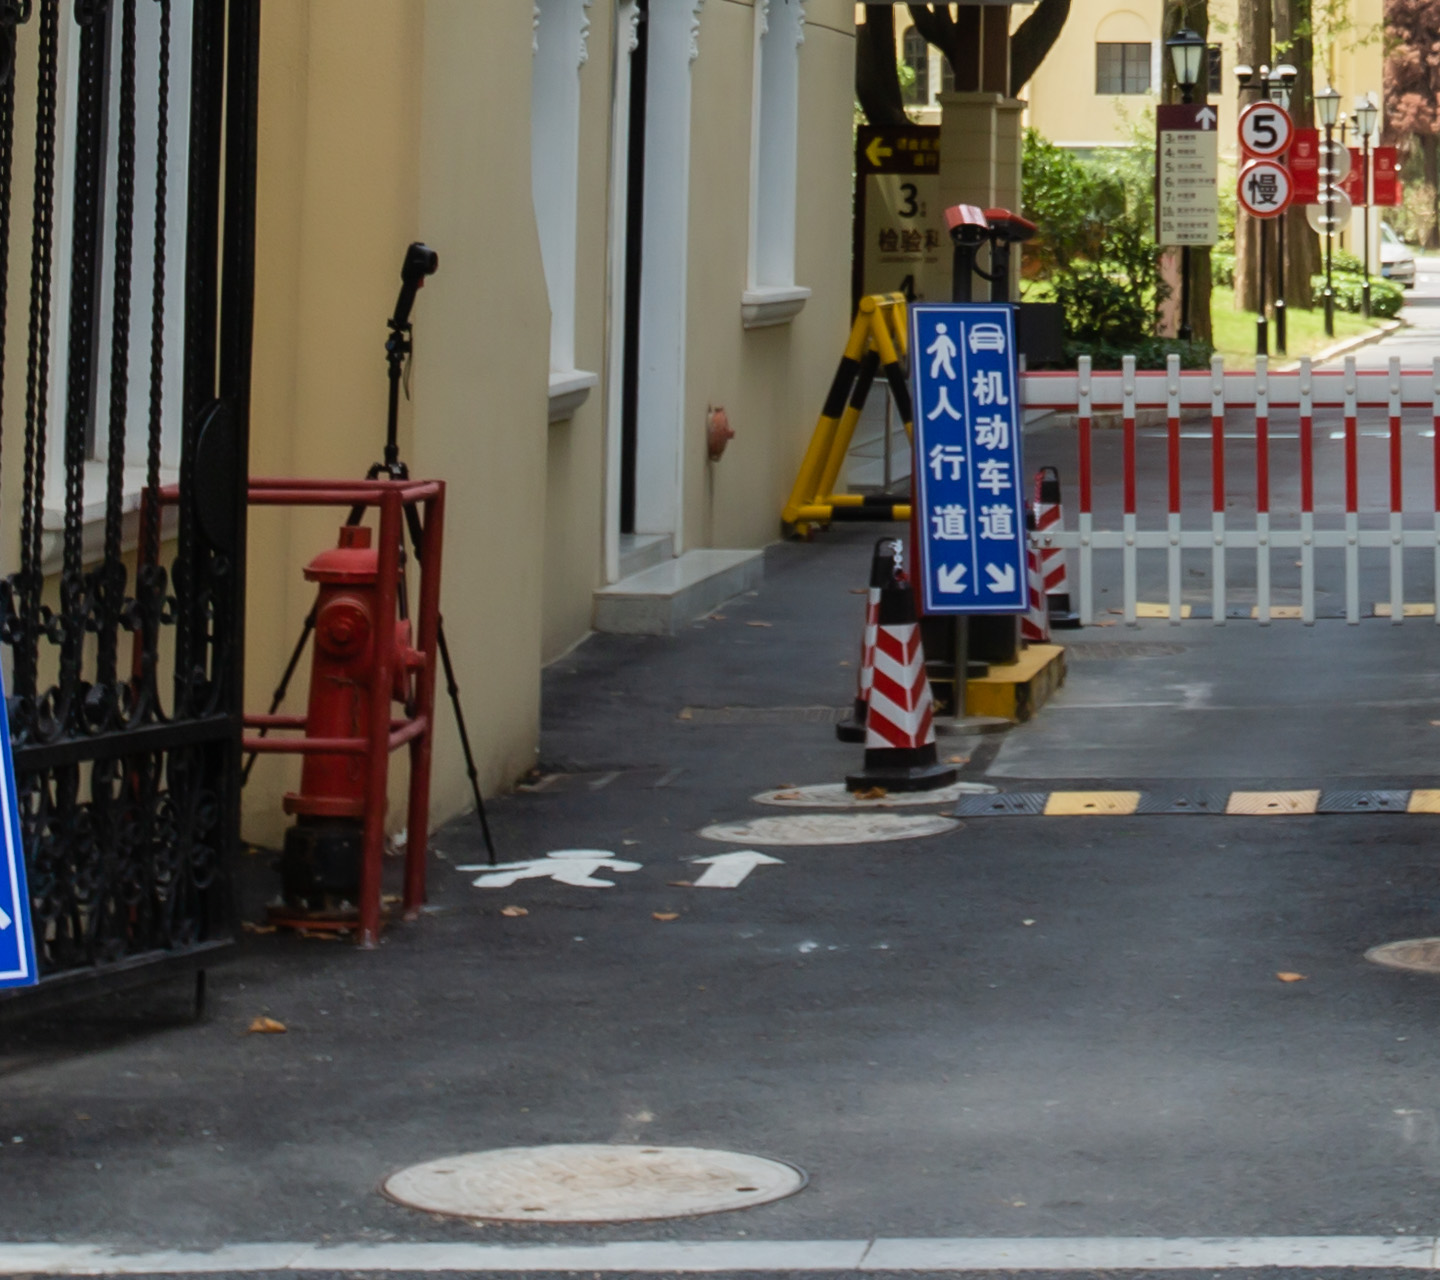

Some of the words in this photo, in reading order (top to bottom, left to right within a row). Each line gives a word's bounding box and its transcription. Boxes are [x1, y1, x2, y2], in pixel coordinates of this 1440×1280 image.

[1253, 114, 1278, 149] 5
[898, 183, 918, 218] 3
[1248, 173, 1278, 205] 慢
[879, 227, 940, 253] 检验科
[926, 386, 970, 543] 人行道
[971, 369, 1016, 542] 机动车道
